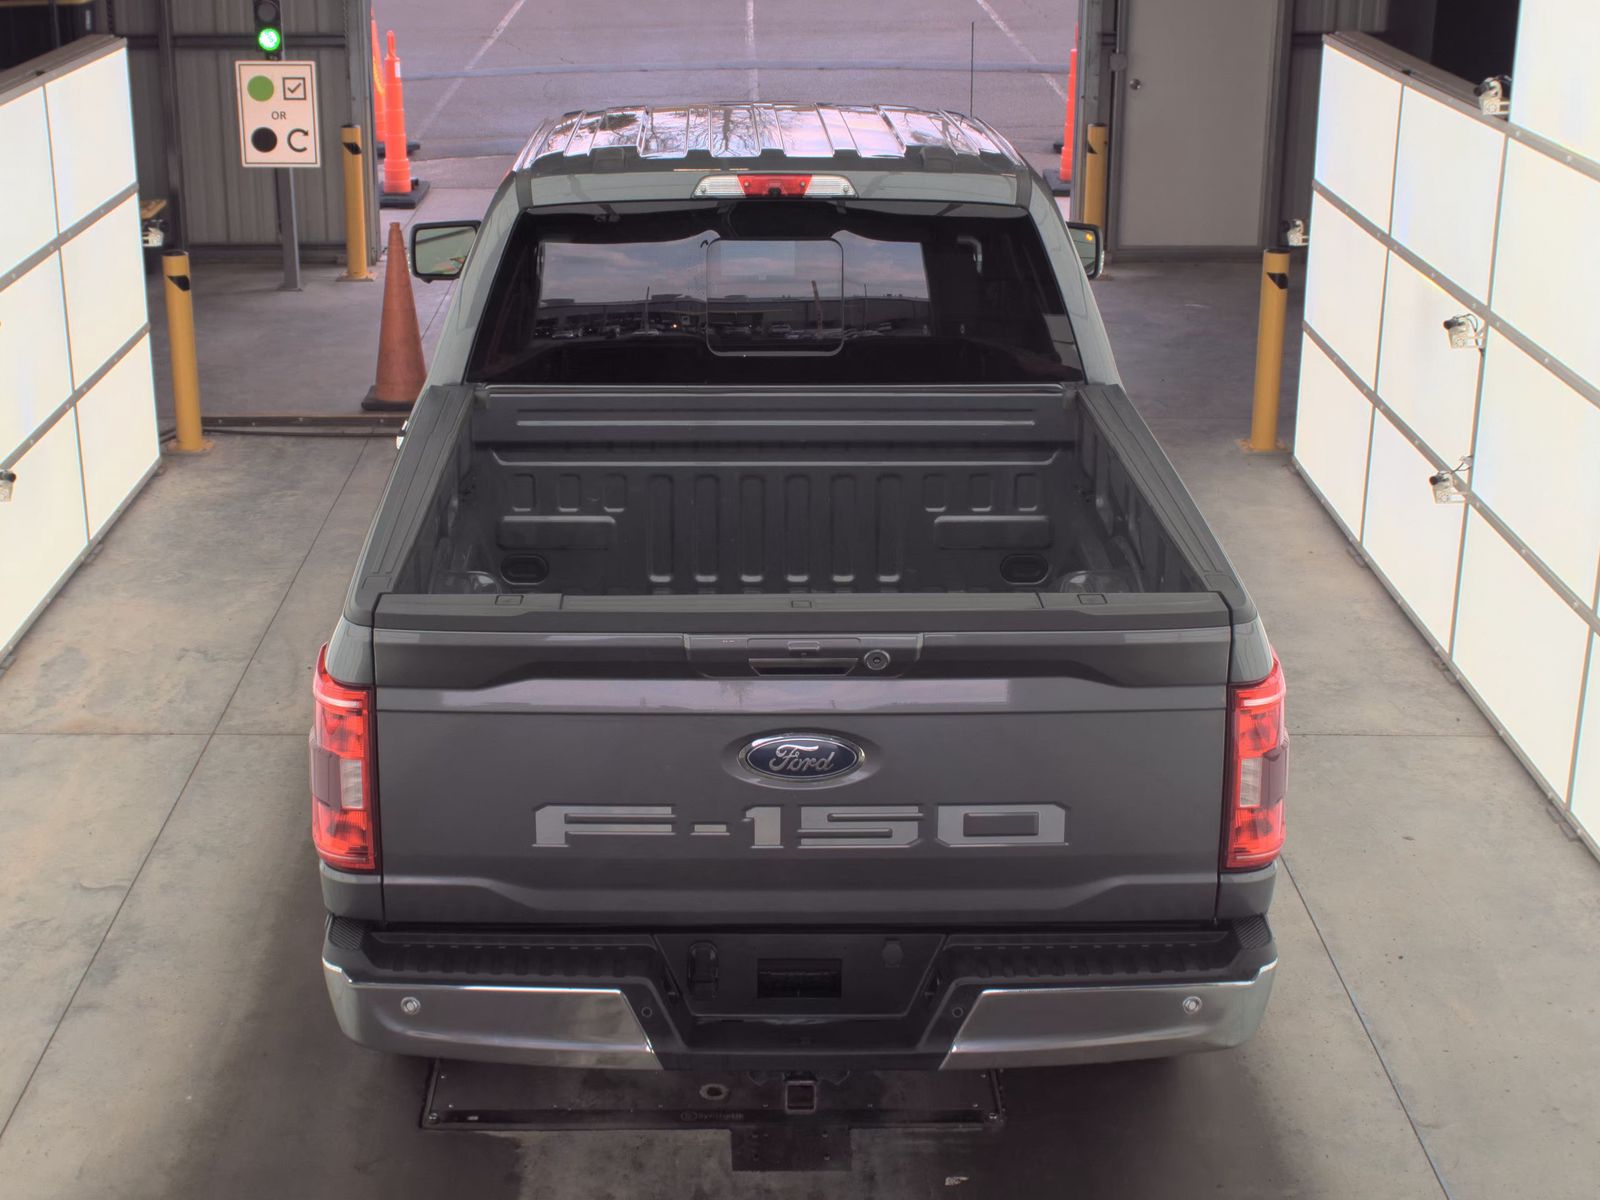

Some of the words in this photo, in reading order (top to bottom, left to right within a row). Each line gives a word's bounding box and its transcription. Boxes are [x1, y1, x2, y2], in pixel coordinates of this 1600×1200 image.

[271, 111, 287, 120] OR
[768, 744, 836, 772] Ford
[532, 804, 1069, 849] F-150
